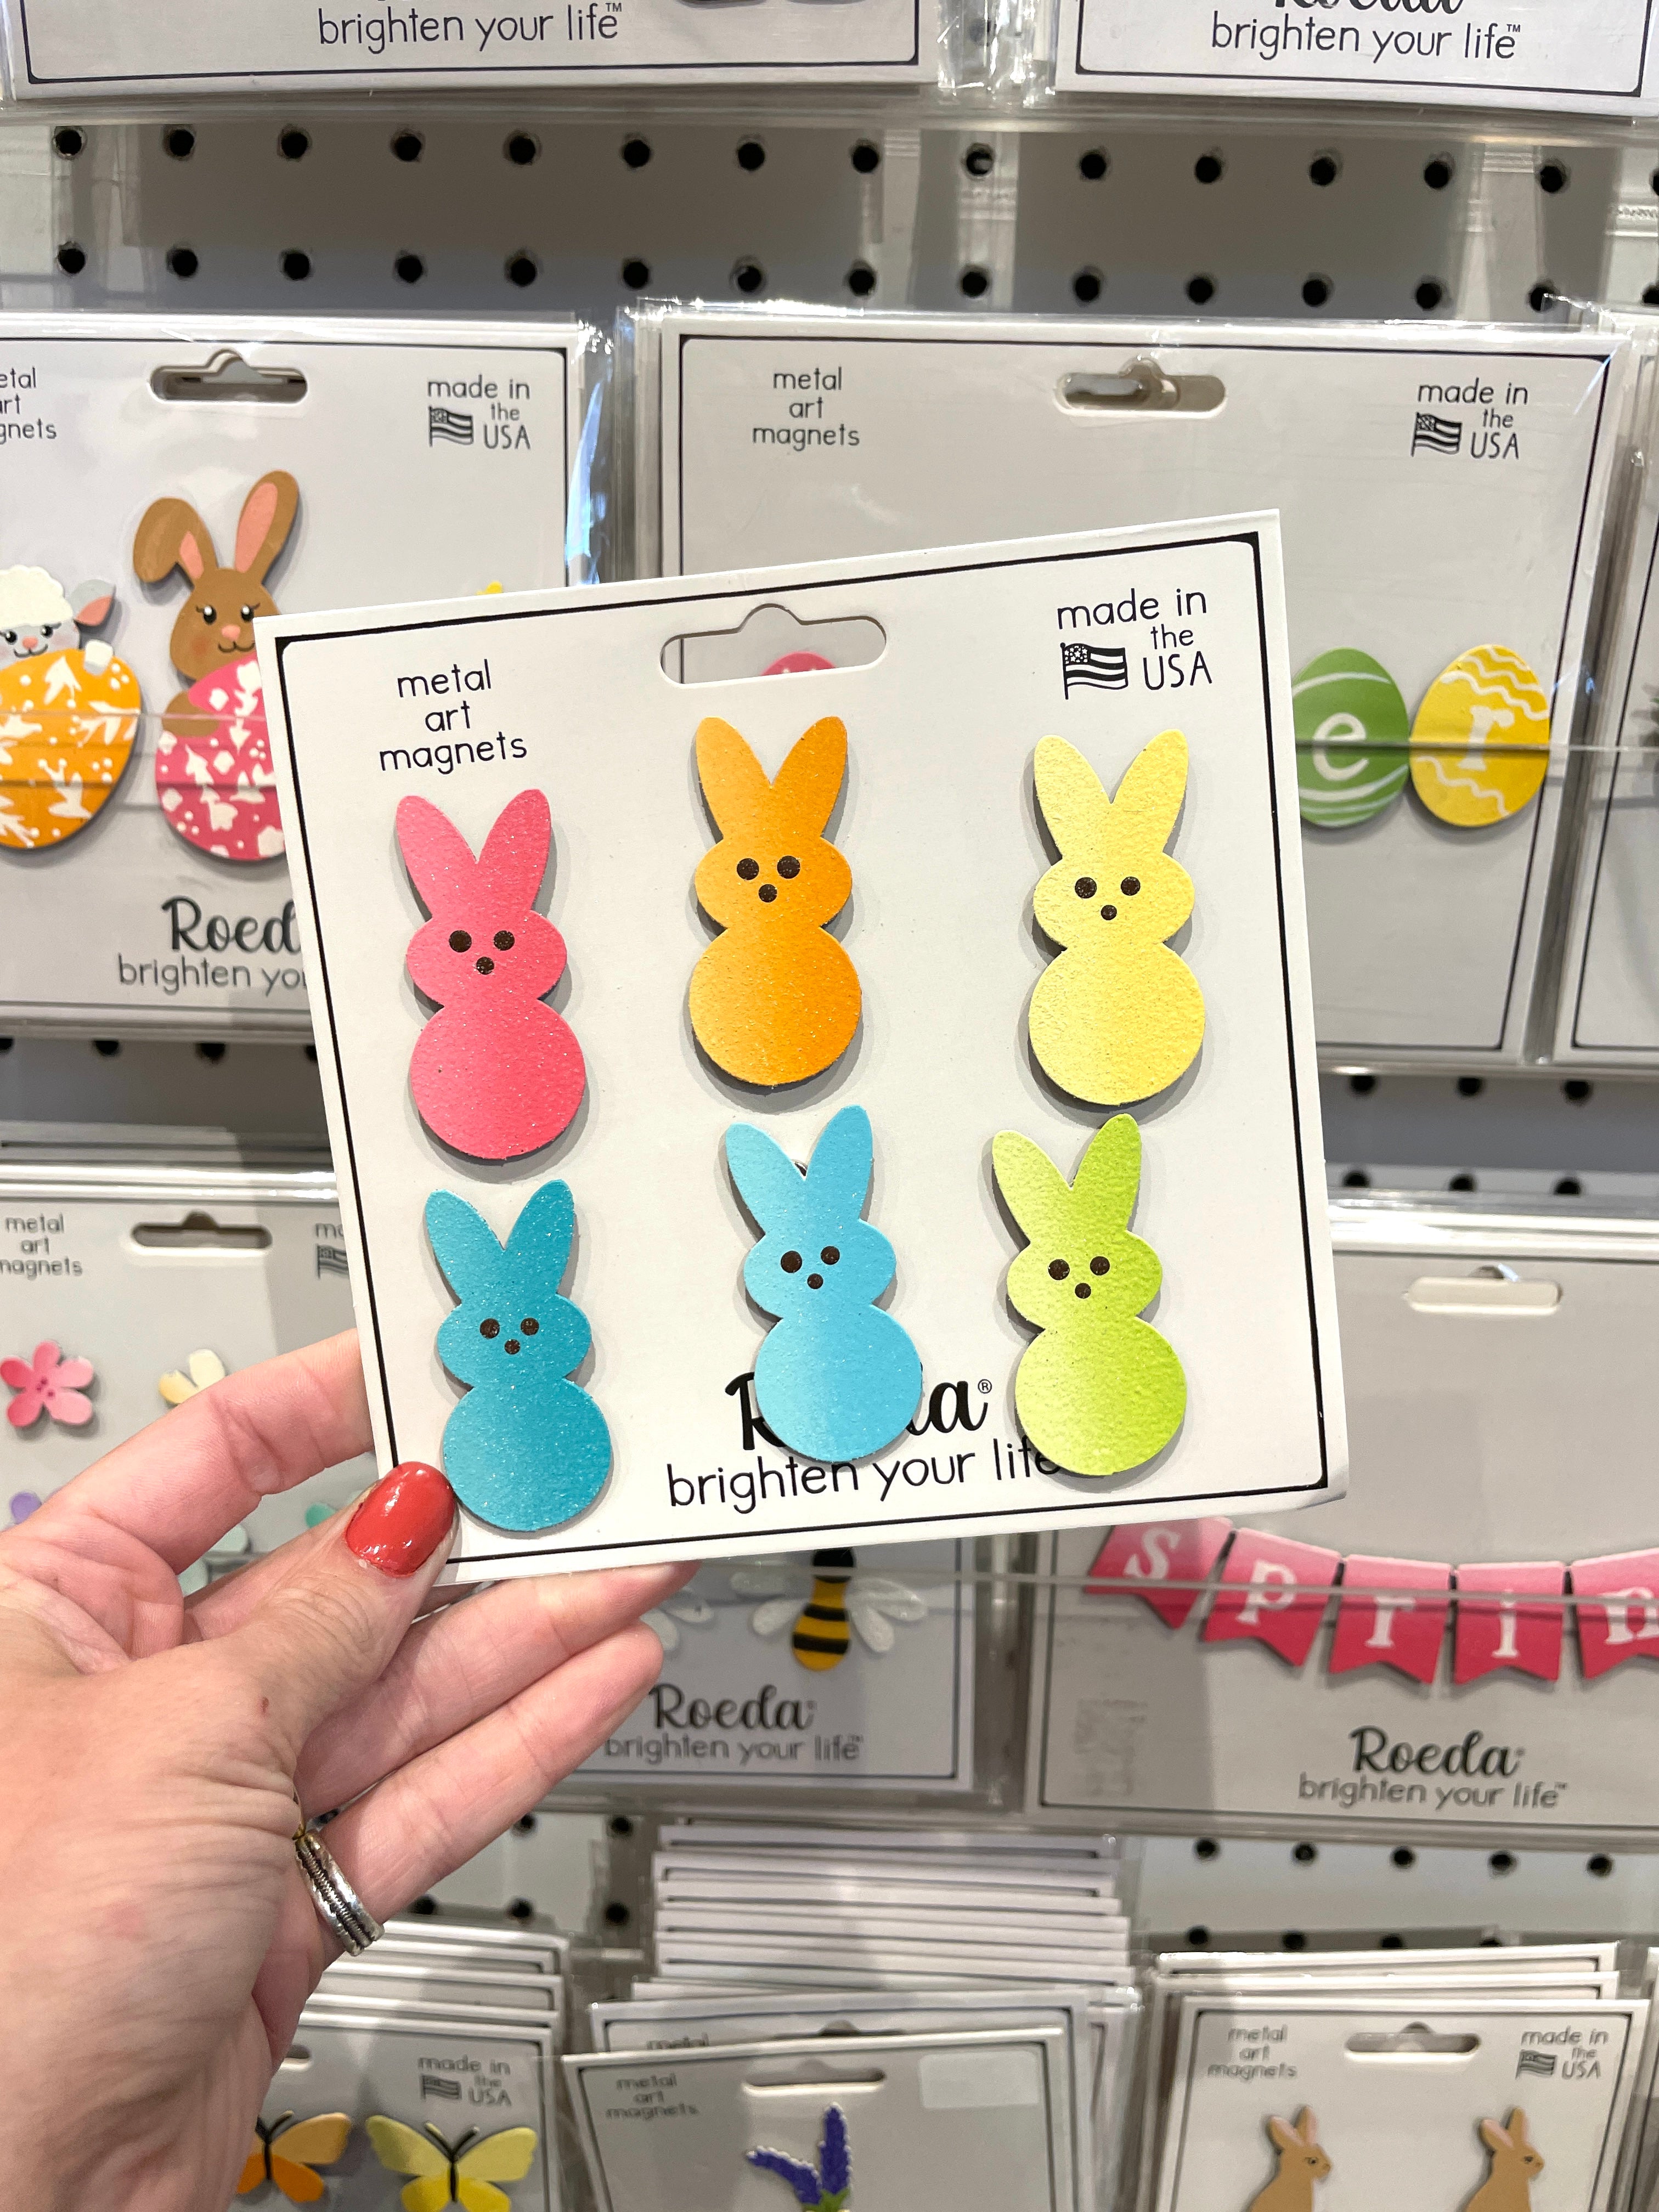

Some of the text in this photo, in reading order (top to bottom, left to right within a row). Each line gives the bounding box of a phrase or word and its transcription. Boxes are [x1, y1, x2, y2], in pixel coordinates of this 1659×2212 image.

[318, 7, 464, 54] brighten
[475, 15, 553, 52] your
[1211, 11, 1359, 60] brighten
[1373, 30, 1452, 63] your
[428, 374, 530, 399] made in
[773, 365, 842, 391] metal
[1418, 377, 1528, 405] made in
[491, 402, 520, 421] the
[788, 396, 823, 419] art
[1482, 408, 1514, 428] the
[483, 424, 531, 450] USA
[752, 424, 860, 452] magnets
[1470, 432, 1519, 460] USA
[1057, 588, 1207, 630] made in
[1150, 623, 1194, 650] the
[397, 658, 492, 698] metal
[1143, 651, 1212, 691] USA
[425, 700, 470, 732] art
[380, 731, 527, 775] magnets
[118, 953, 252, 996] brighten
[5, 1212, 65, 1234] metal
[20, 1235, 50, 1255] art
[667, 1455, 859, 1514] brighten
[872, 1452, 975, 1502] your
[605, 1731, 730, 1765] brighten
[737, 1740, 807, 1767] your
[1298, 1771, 1427, 1809] brighten
[1435, 1786, 1505, 1811] your
[1521, 2025, 1610, 2045] made in
[419, 2053, 481, 2073] made
[1562, 2060, 1601, 2080] USA
[468, 2086, 512, 2107] USA
